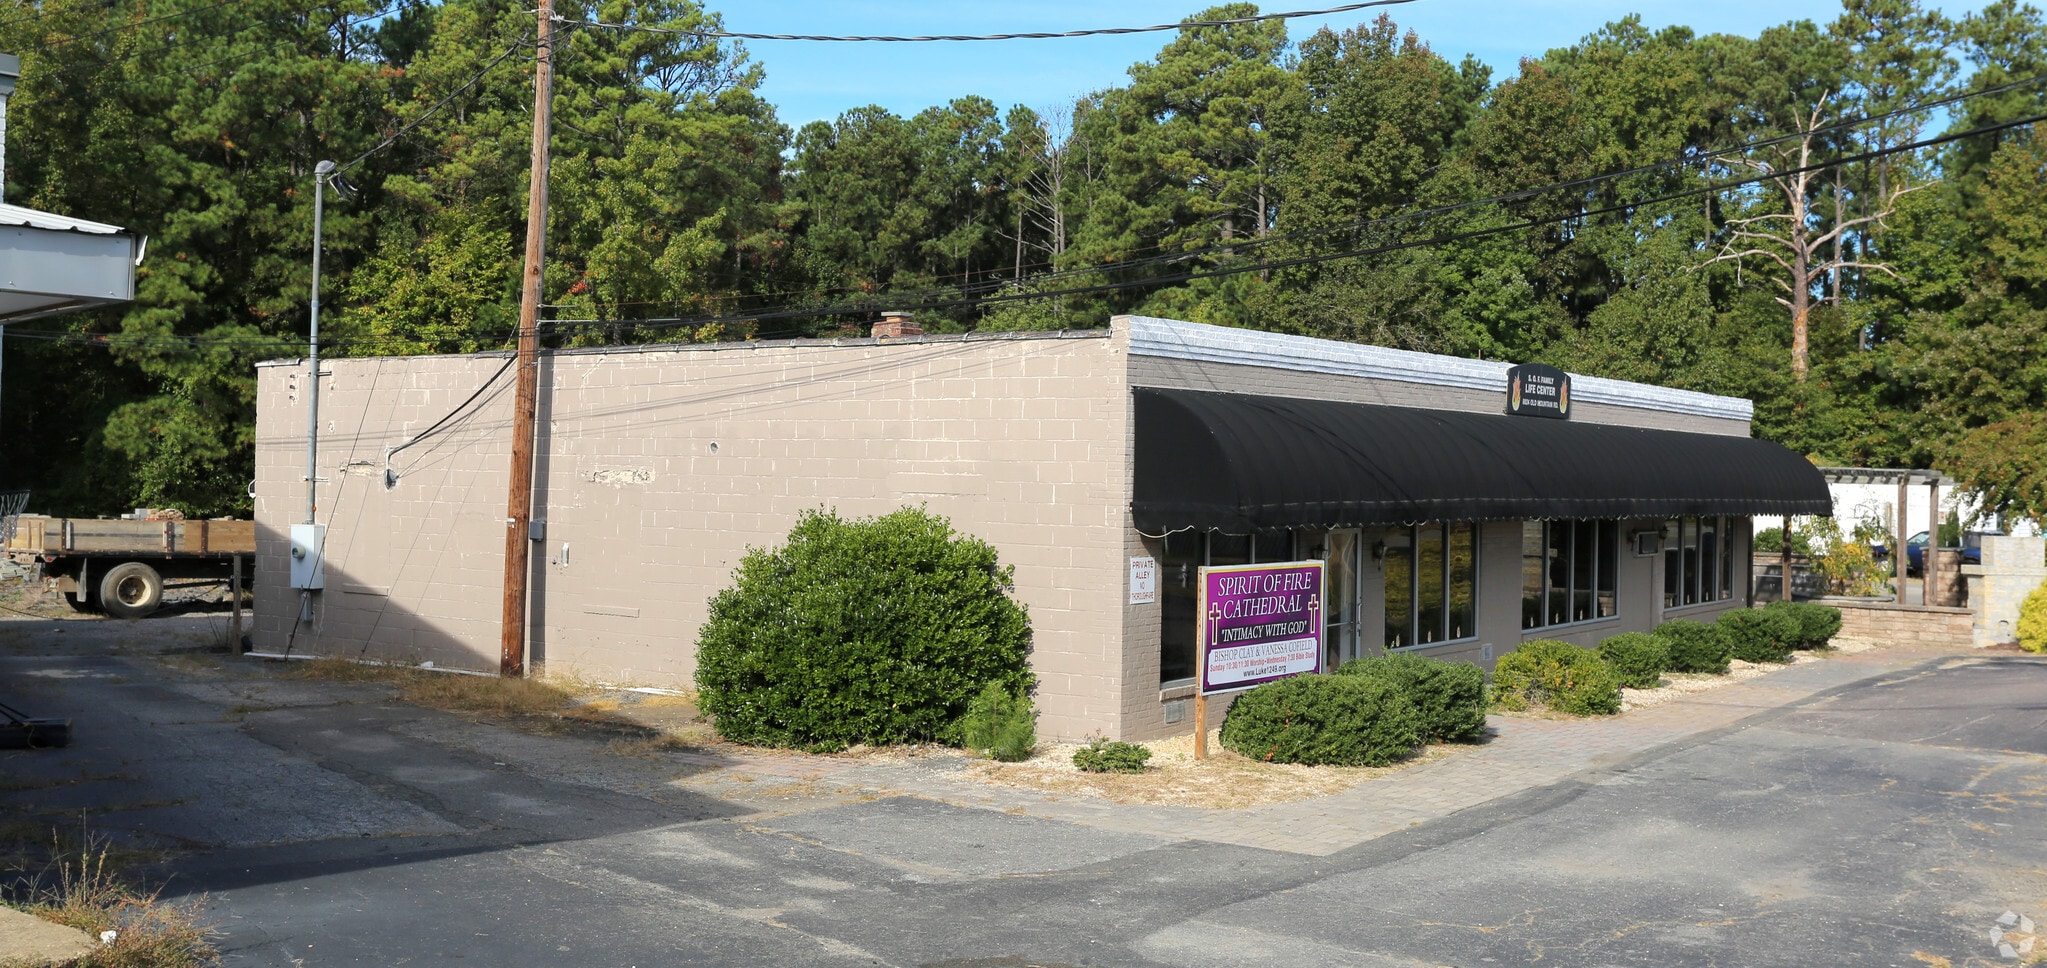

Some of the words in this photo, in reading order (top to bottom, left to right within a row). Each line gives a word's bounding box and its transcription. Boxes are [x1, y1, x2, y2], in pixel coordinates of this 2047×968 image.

[1541, 376, 1554, 385] FAMILY
[1525, 384, 1536, 394] LIFE
[1536, 385, 1556, 396] CENTER
[1132, 560, 1154, 569] PRIVATE
[1136, 571, 1150, 579] ALLEY
[1218, 575, 1261, 597] SPIRIT
[1263, 573, 1282, 593] OF
[1283, 572, 1312, 591] FIRE
[1223, 594, 1302, 619] CATHEDRAL
[1264, 624, 1287, 637] WITH
[1214, 647, 1238, 662] BISHOP
[1238, 646, 1257, 660] CLAY
[1261, 642, 1288, 656] VANESSA
[1288, 639, 1313, 653] COFIELD
[1209, 663, 1226, 673] Sunday
[1305, 651, 1316, 660] Study
